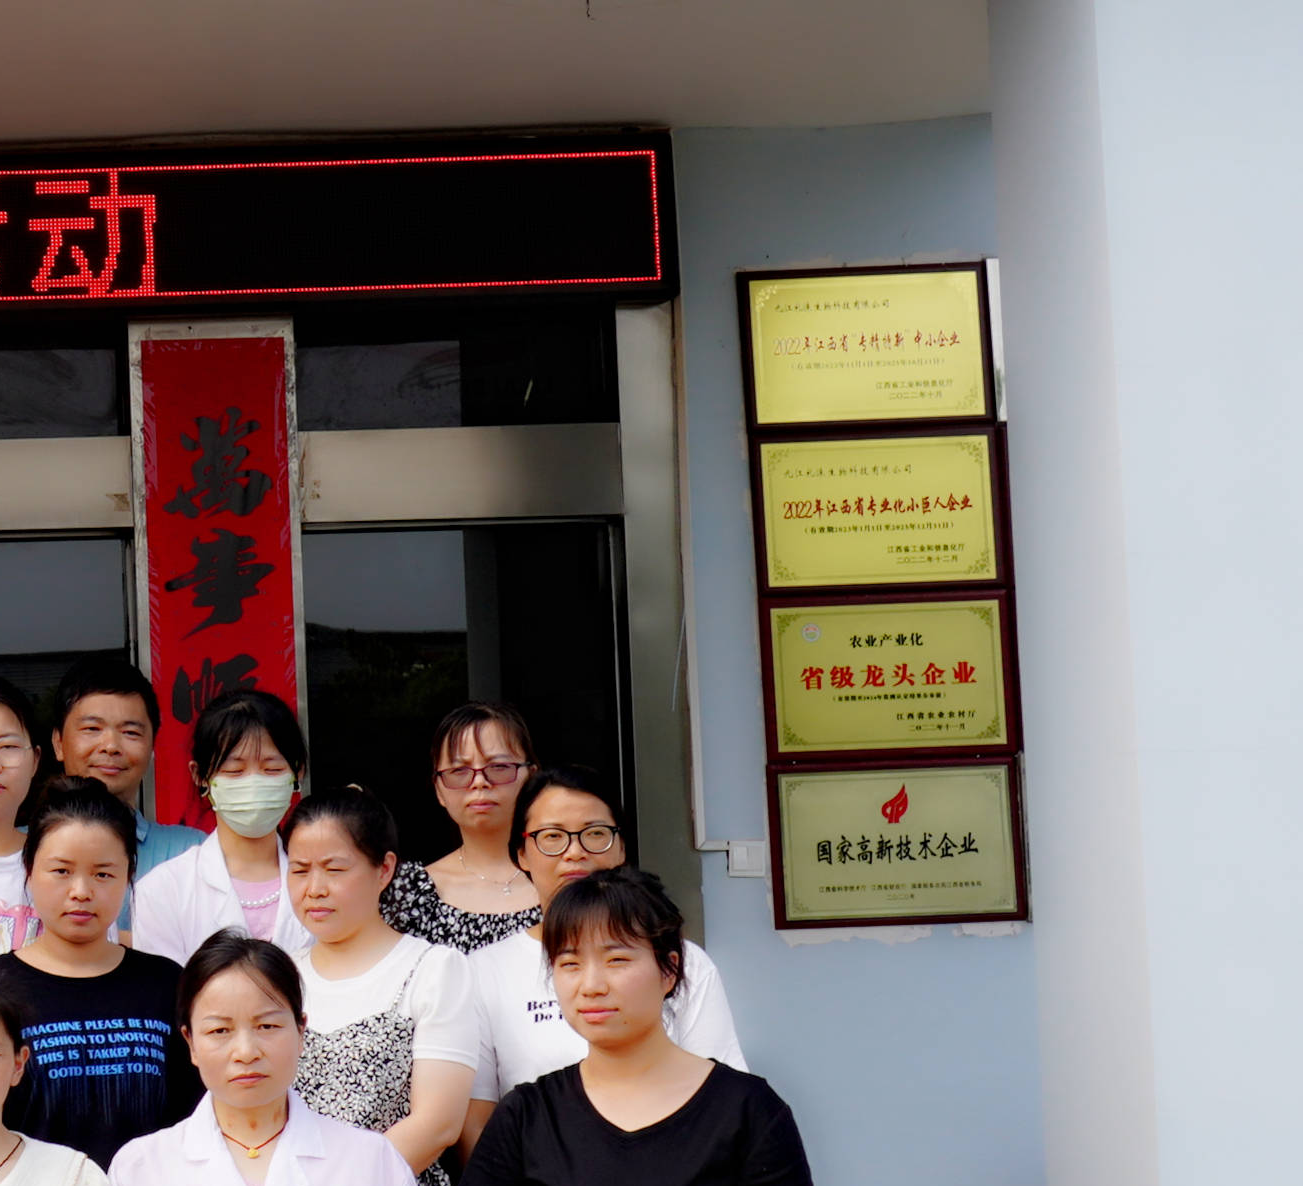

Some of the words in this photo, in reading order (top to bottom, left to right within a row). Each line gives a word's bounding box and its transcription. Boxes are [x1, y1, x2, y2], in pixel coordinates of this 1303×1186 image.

[850, 633, 923, 648] 农业产业化
[800, 661, 977, 690] 省级龙头企业
[817, 832, 979, 865] 国家高新技术企业
[527, 1000, 559, 1012] Ber
[84, 1018, 125, 1031] PLEASE
[127, 1018, 143, 1029] BE
[535, 1013, 553, 1023] Do
[33, 1034, 87, 1051] FASHION
[87, 1034, 106, 1045] TO
[36, 1050, 64, 1065] THIS
[68, 1049, 80, 1060] IS
[133, 1046, 149, 1057] AN
[126, 1062, 143, 1073] TO
